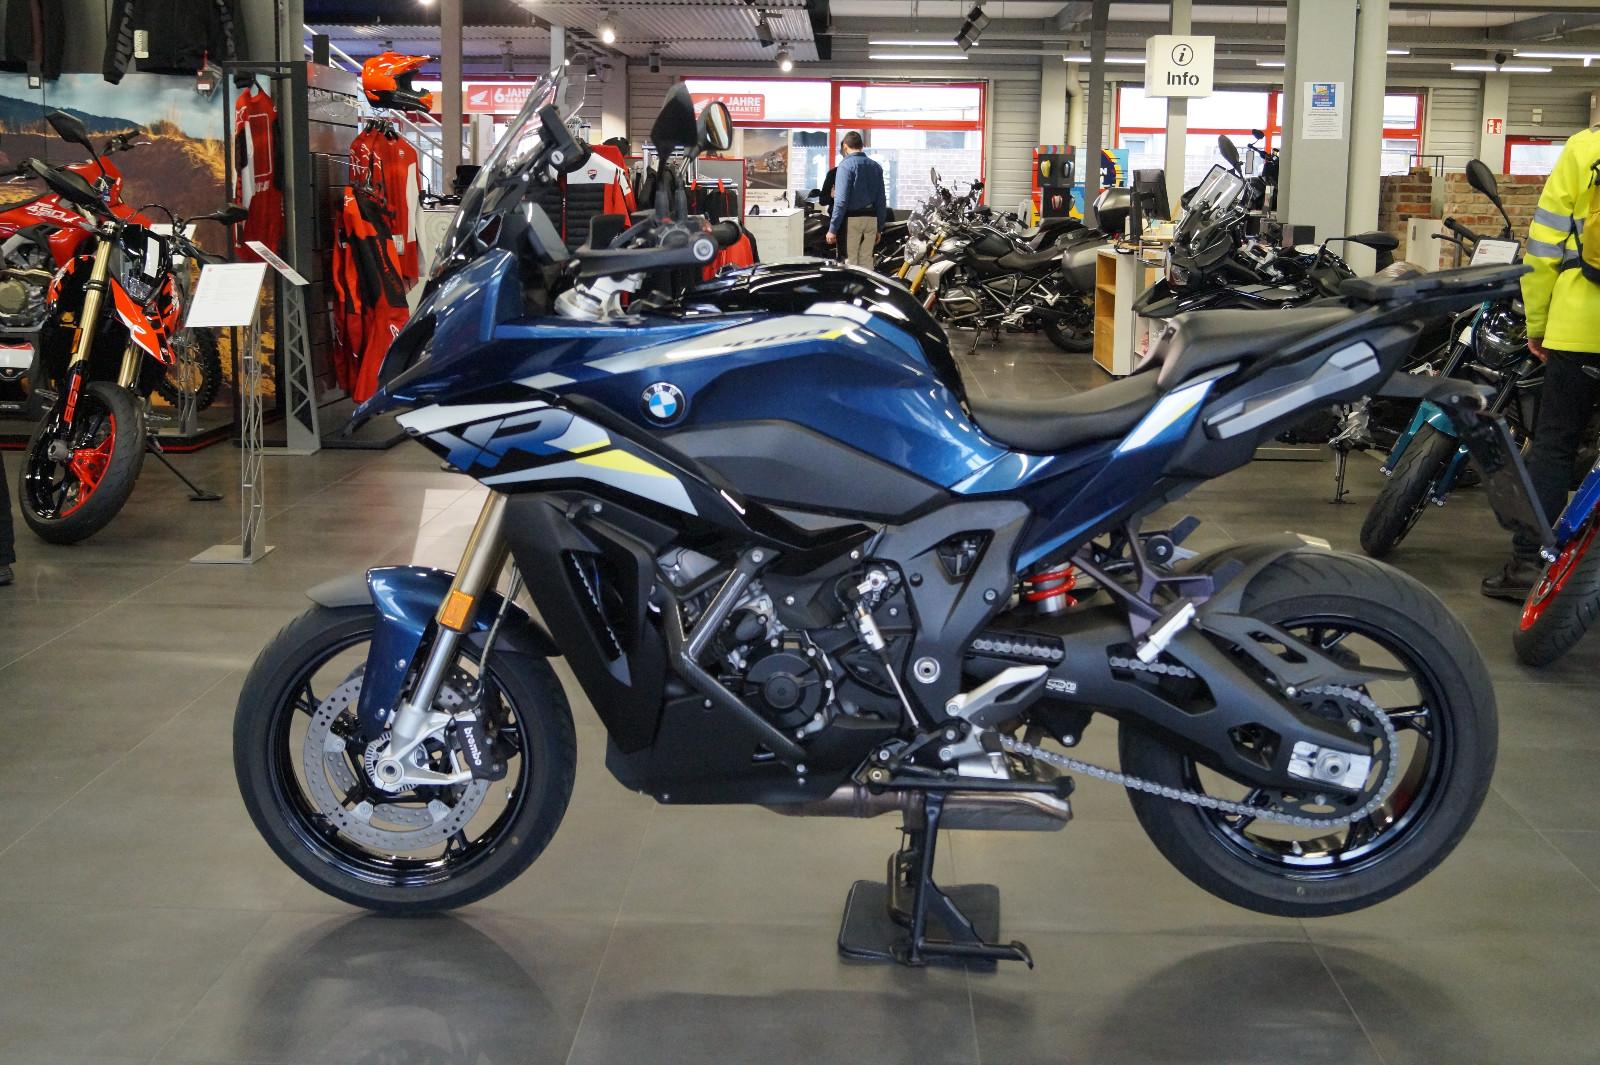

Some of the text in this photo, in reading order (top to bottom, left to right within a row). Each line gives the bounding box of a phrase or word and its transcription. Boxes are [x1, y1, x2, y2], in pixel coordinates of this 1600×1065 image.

[1167, 72, 1199, 86] Info
[494, 88, 531, 103] 6 JAHR
[725, 96, 761, 106] JAHRE
[643, 384, 679, 401] BMW
[427, 408, 575, 472] XR
[464, 726, 482, 766] brembo
